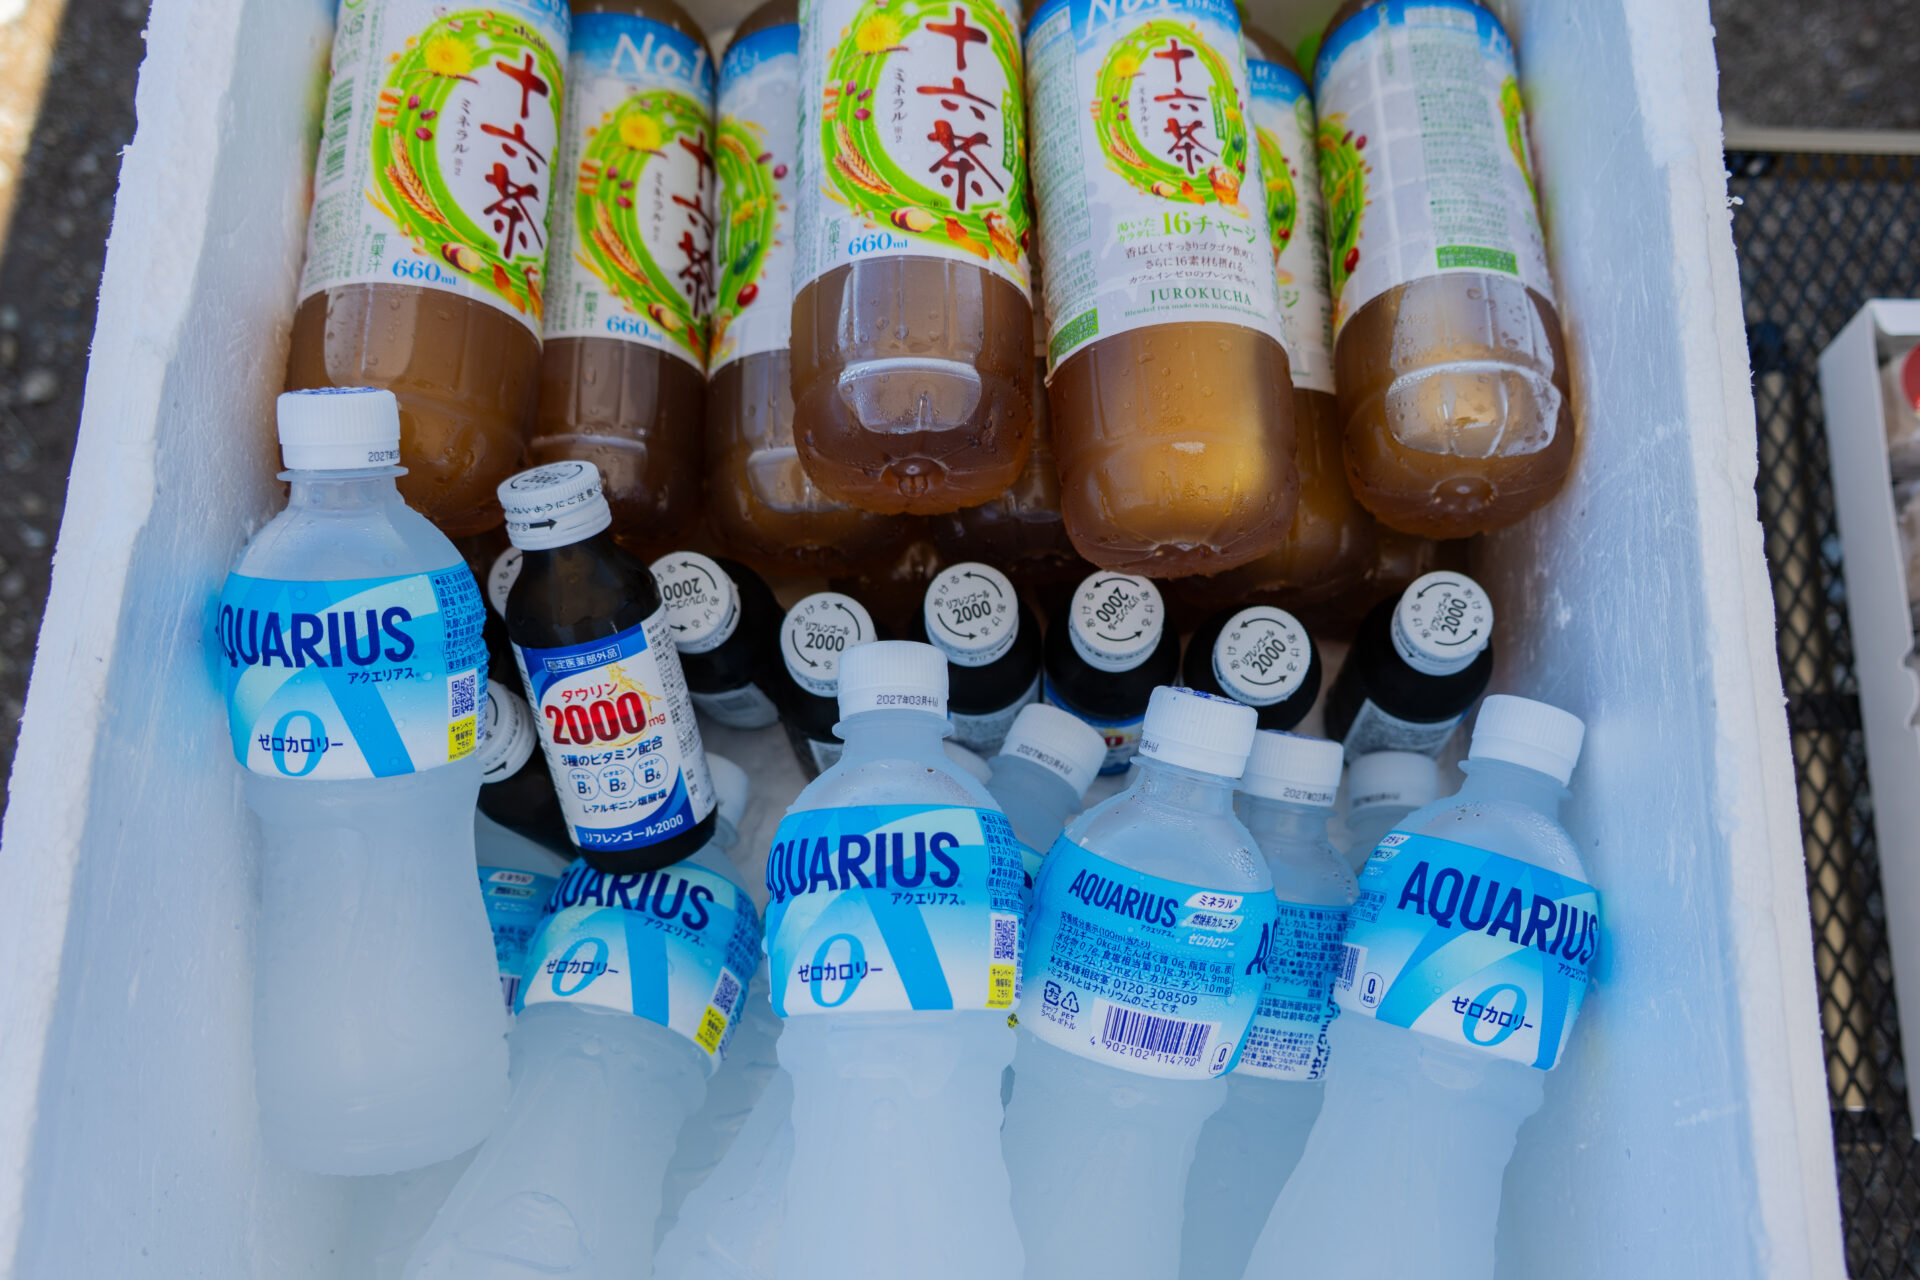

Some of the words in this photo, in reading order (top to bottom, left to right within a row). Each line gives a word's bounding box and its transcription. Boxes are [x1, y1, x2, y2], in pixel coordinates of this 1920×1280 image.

[890, 67, 908, 123] ミネラル
[916, 7, 1004, 212] 十六茶
[1154, 38, 1219, 175] 十六茶
[452, 97, 472, 155] ミネラル
[481, 52, 549, 260] 十六茶
[369, 232, 387, 274] 無果汁
[847, 232, 909, 257] 660ml
[391, 257, 458, 287] 660ml
[1150, 286, 1253, 306] JUROKUCHA
[662, 577, 703, 602] 2000
[945, 589, 991, 611] リフレンゴール
[952, 600, 993, 625] 2000
[1095, 586, 1130, 624] 2000
[1441, 597, 1469, 637] 2000
[217, 603, 416, 669] QUARIUS
[804, 631, 846, 653] 2000
[805, 622, 851, 637] リフレンゴール
[1240, 628, 1277, 667] リフレンゴール
[1251, 638, 1288, 677] 2000
[346, 667, 416, 685] アクエリアス
[560, 681, 619, 704] タウリン
[545, 691, 647, 746] 2000
[648, 712, 667, 729] mg
[257, 734, 344, 754] ゼロカロリー
[271, 709, 327, 777] 0
[560, 734, 664, 768] 3種のビタミン配合
[602, 768, 626, 779] ビタミン
[638, 757, 660, 771] ビタミン
[644, 767, 662, 785] B6
[576, 780, 593, 796] B1
[608, 776, 628, 794] B2
[582, 788, 669, 815] L-アルギニン塩酸塩
[584, 812, 685, 845] リフレンゴール2000
[768, 831, 961, 905] QUARIUS
[890, 892, 960, 906] アクエリアス
[1068, 869, 1179, 930] AQUARIUS
[1397, 861, 1599, 967] AQUARIUS
[642, 916, 702, 946] アクエリアス
[1140, 924, 1174, 938] アクエリアス
[1188, 934, 1236, 950] ゼロカロリー
[545, 959, 619, 977] ゼロカロリー
[551, 936, 610, 998] 0
[797, 961, 884, 984] ゼロカロリー
[809, 933, 866, 1008] 0
[1112, 977, 1199, 1006] 0120-308509
[1204, 983, 1232, 996] 10mg
[1367, 977, 1377, 996] 0
[1060, 1011, 1075, 1021] PET
[1451, 995, 1534, 1032] ゼロカロリー
[1461, 982, 1529, 1048] 0
[1089, 1035, 1097, 1047] 4
[1105, 1038, 1149, 1060] 902102
[1156, 1053, 1197, 1067] 114790
[1217, 1047, 1228, 1063] 0
